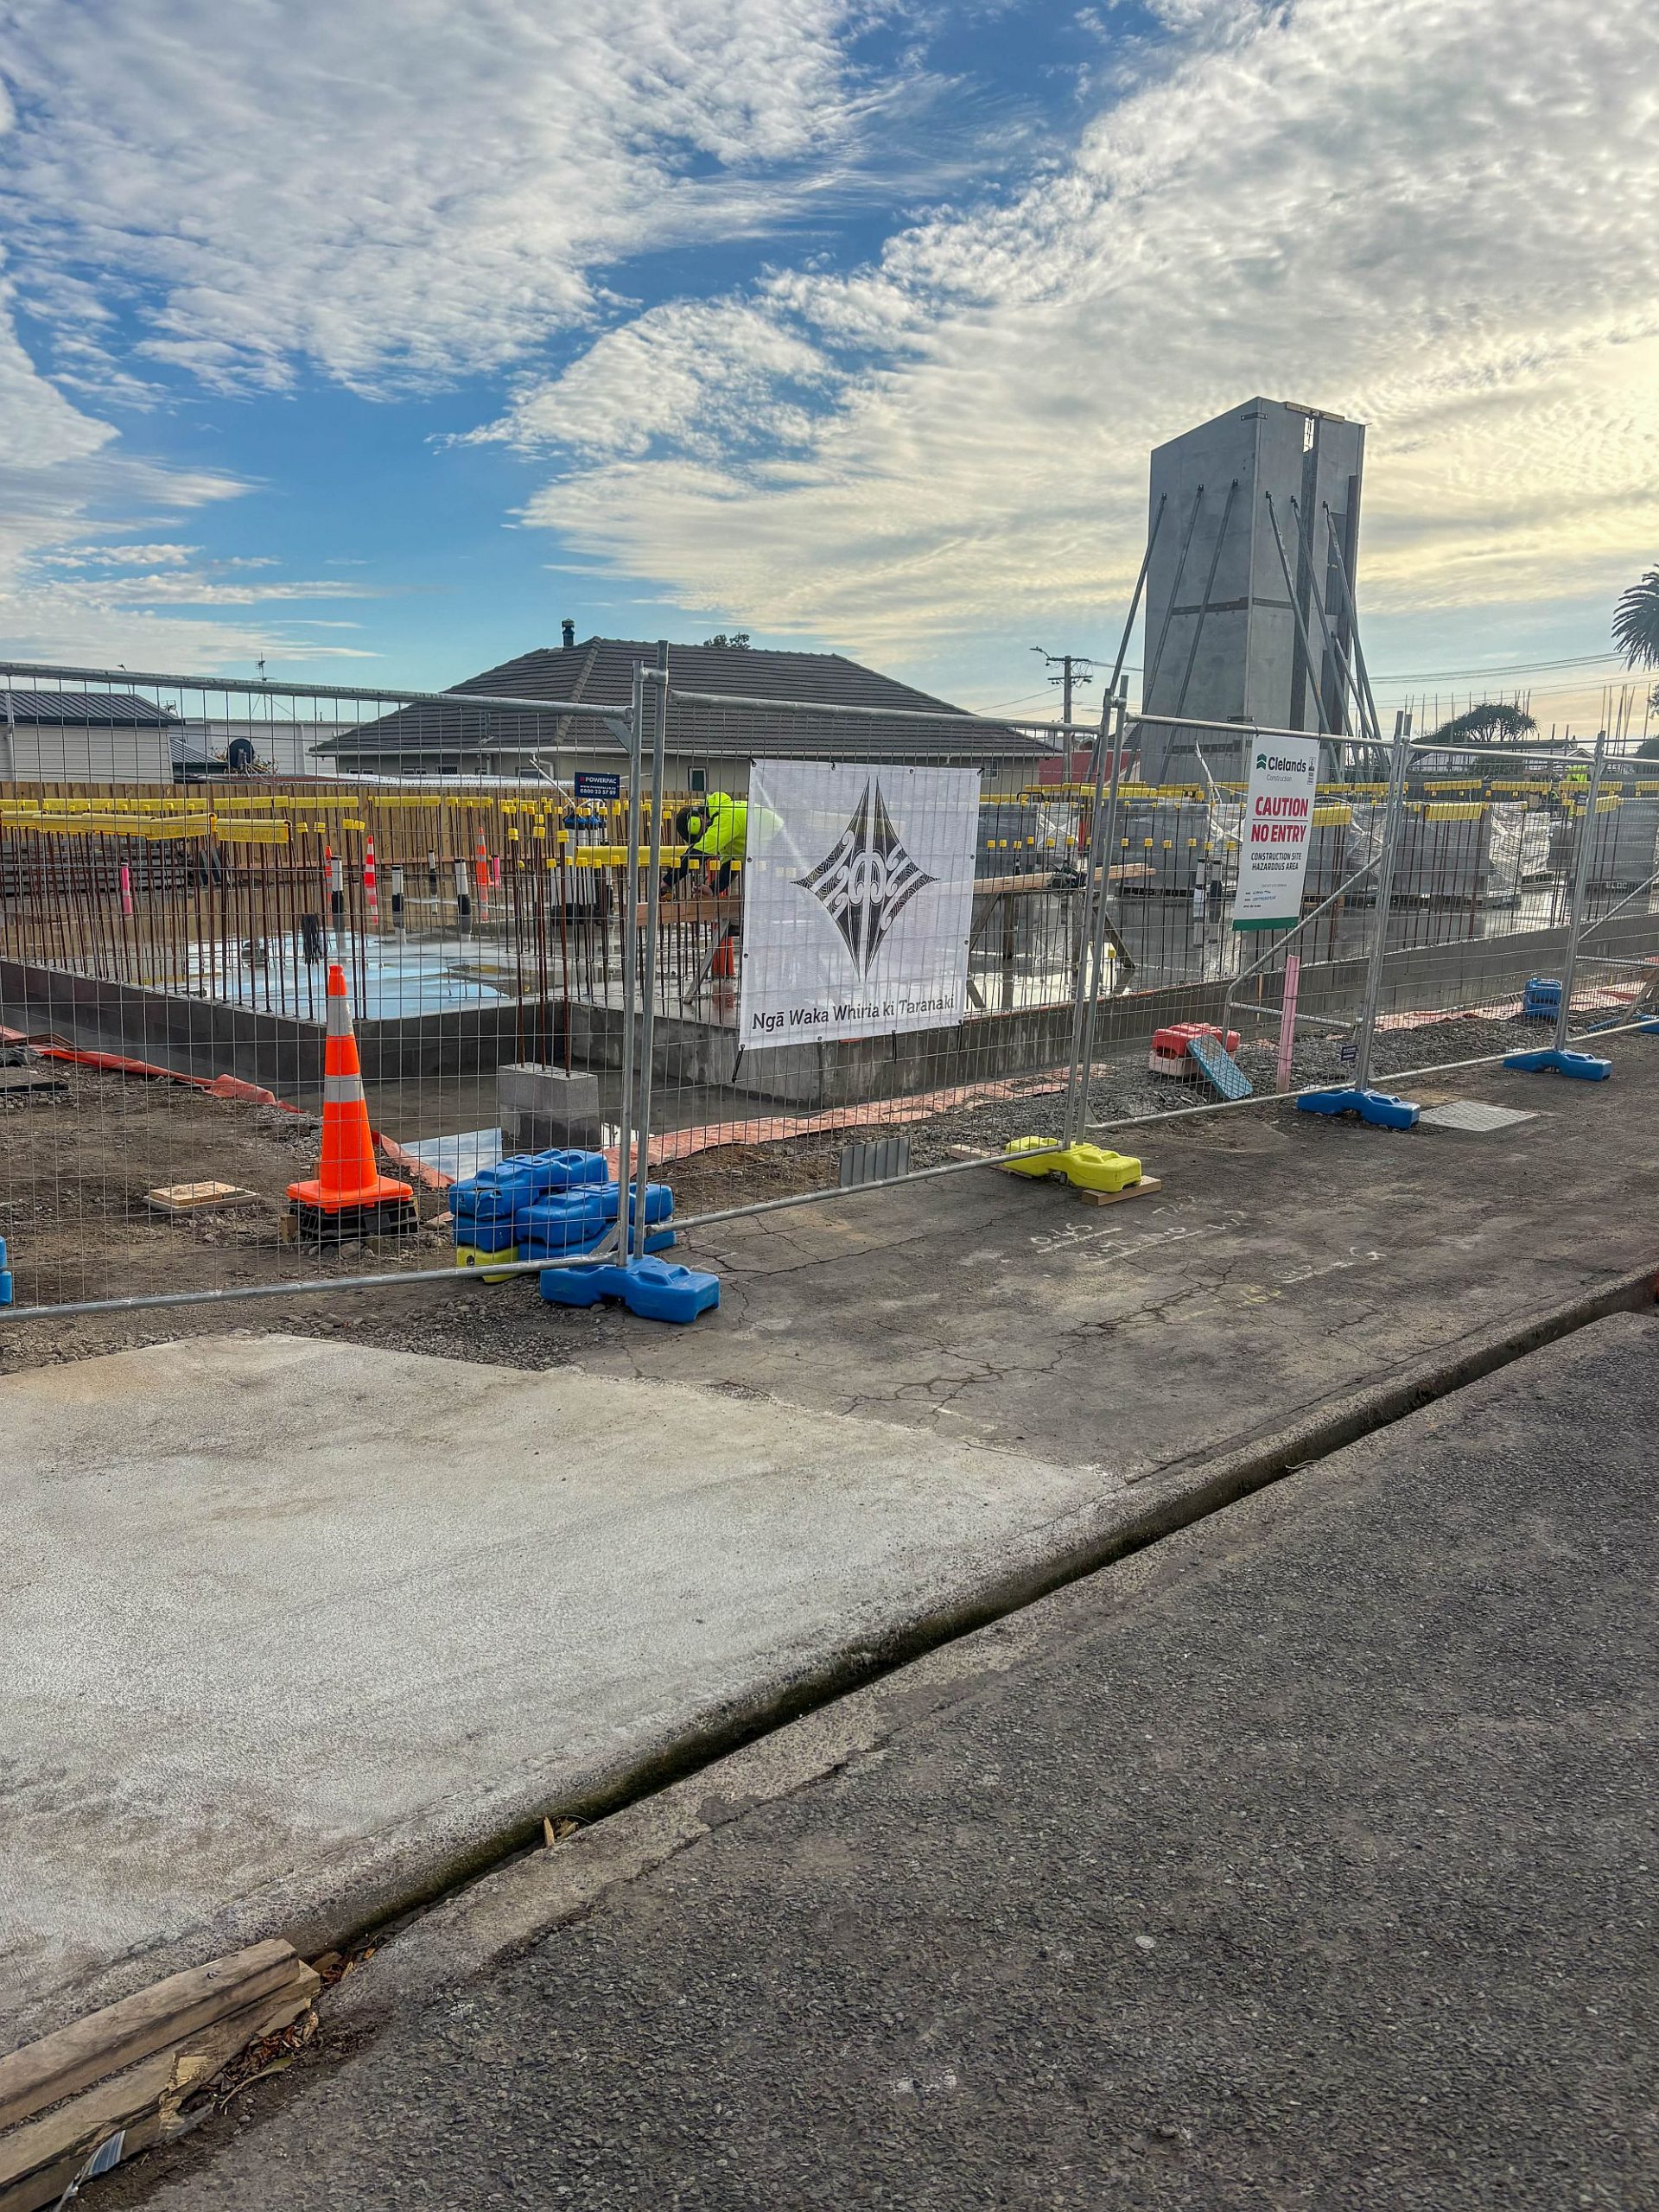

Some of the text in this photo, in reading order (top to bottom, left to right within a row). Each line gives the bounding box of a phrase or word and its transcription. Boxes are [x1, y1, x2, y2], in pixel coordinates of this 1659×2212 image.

[1268, 756, 1306, 772] Clelands
[1255, 796, 1308, 817] CAUTION
[1251, 824, 1306, 842] NO ENTRY
[1251, 852, 1302, 861] CONSTRUCTION SITE
[1252, 862, 1299, 871] HAZARDOUS AREA
[752, 994, 954, 1033] Ngā Waka Whiria ki Taranaki
